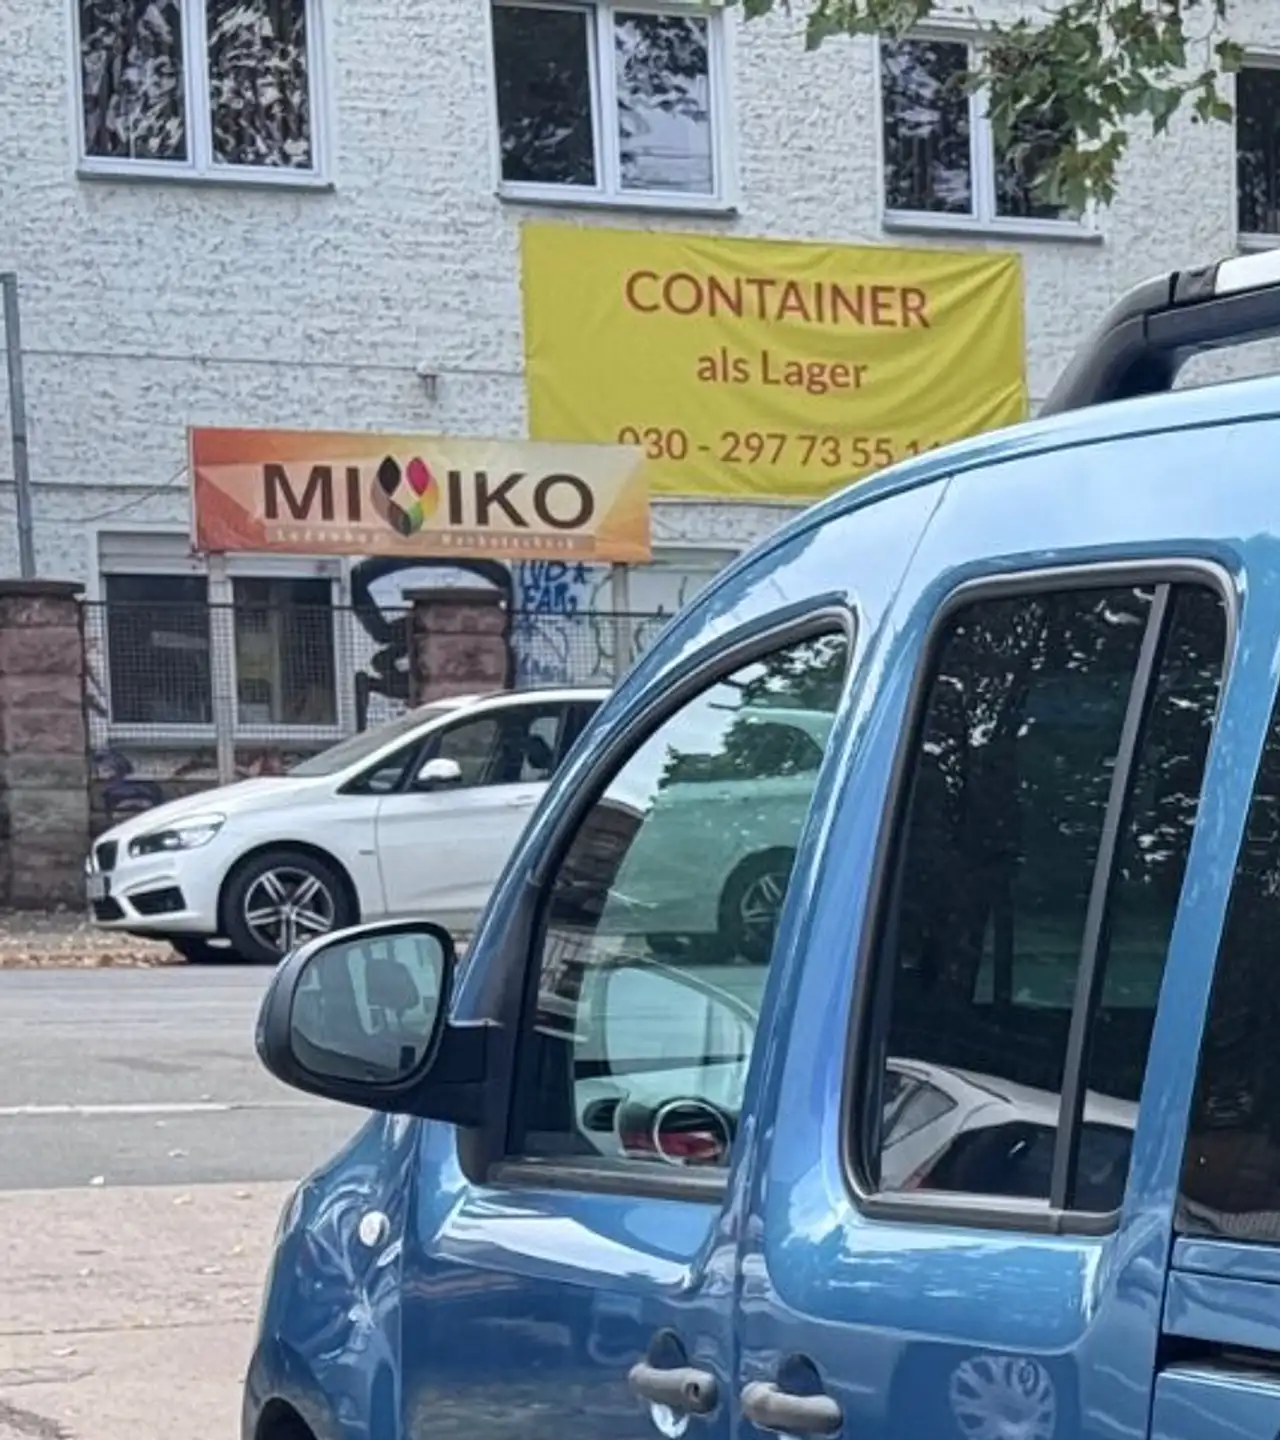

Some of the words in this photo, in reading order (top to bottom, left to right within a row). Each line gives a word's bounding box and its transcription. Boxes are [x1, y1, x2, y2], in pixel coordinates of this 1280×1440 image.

[625, 270, 931, 328] CONTAINER
[697, 346, 750, 383] als
[761, 349, 868, 395] Lager
[719, 431, 788, 463] 297
[798, 434, 841, 467] 73
[851, 437, 893, 468] 55
